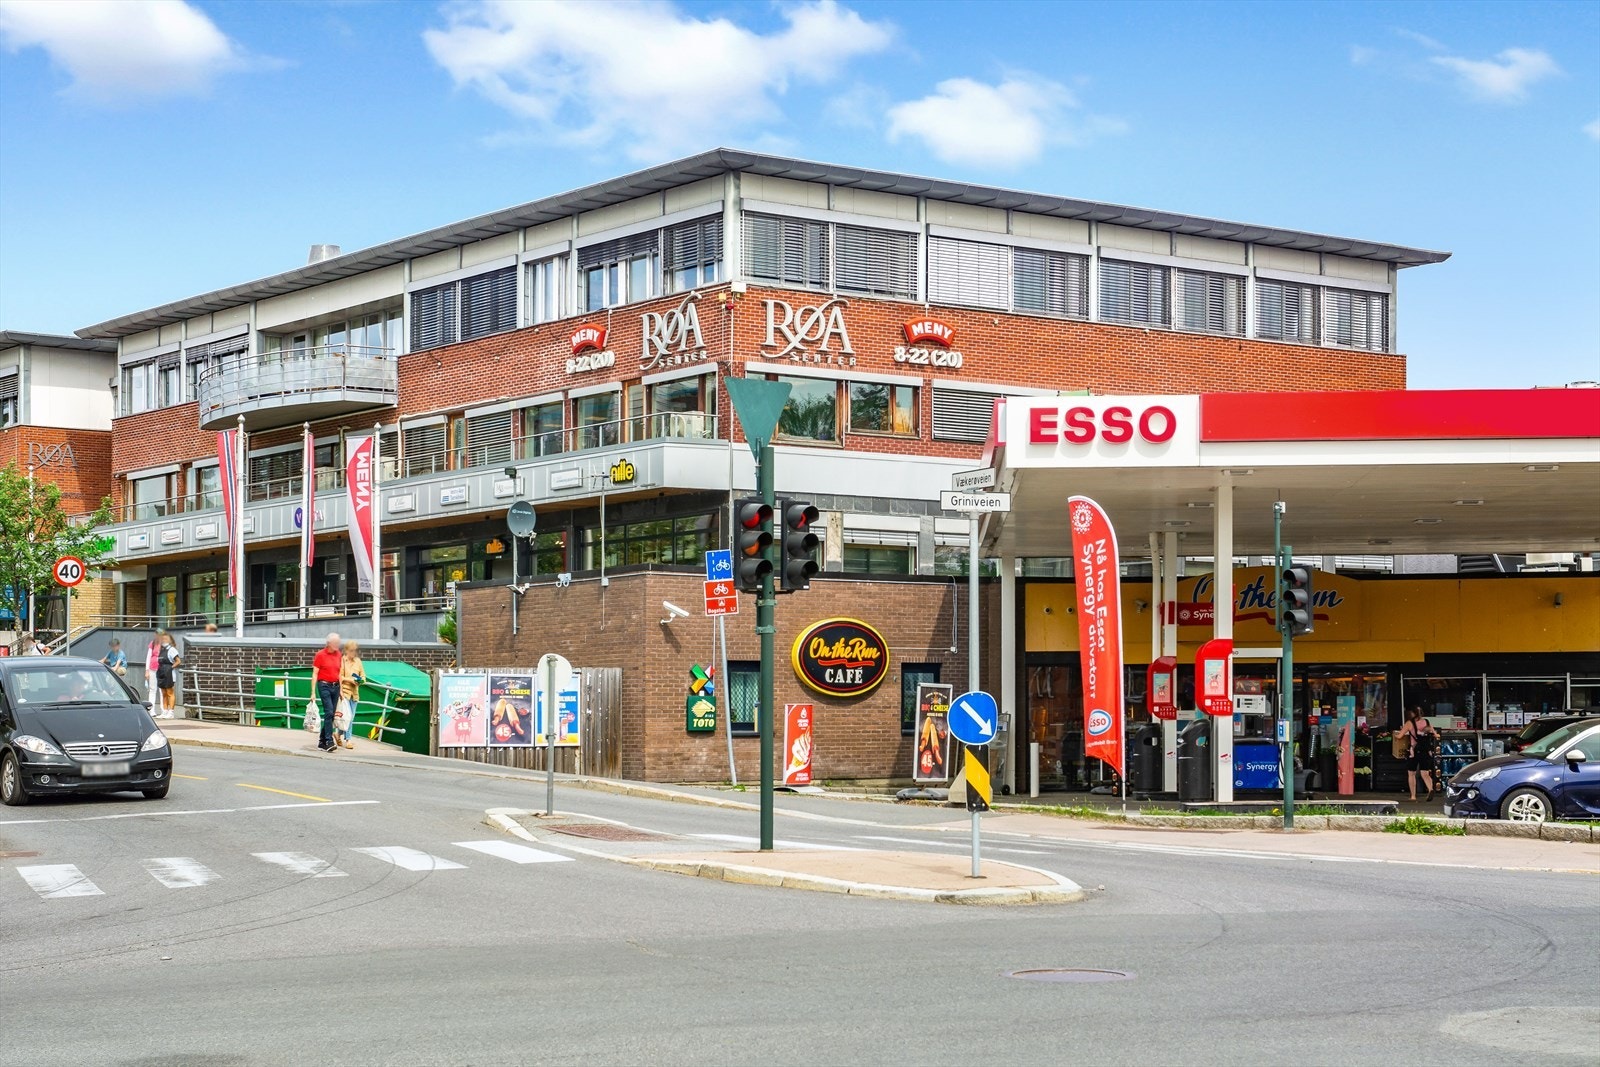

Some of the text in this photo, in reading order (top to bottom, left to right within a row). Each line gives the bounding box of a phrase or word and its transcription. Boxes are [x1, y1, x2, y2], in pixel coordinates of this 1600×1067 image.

[571, 328, 600, 347] MENY
[639, 290, 706, 370] RØA
[761, 300, 856, 358] RØA
[911, 321, 952, 339] MENY
[658, 350, 708, 368] SENTER
[789, 351, 857, 366] SENTER
[893, 347, 963, 368] 8-22 (20)
[1029, 405, 1177, 444] ESSO
[25, 440, 80, 470] RØA
[610, 459, 635, 484] nille
[955, 473, 992, 488] Vækerøveien
[950, 495, 1001, 508] Griniveien
[1095, 538, 1107, 565] Nå
[59, 564, 80, 579] 40
[1096, 569, 1107, 602] hos
[809, 637, 881, 661] On the Run
[825, 667, 863, 684] CAFÉ
[692, 718, 715, 727] TOTO
[1246, 762, 1278, 772] Synergy
